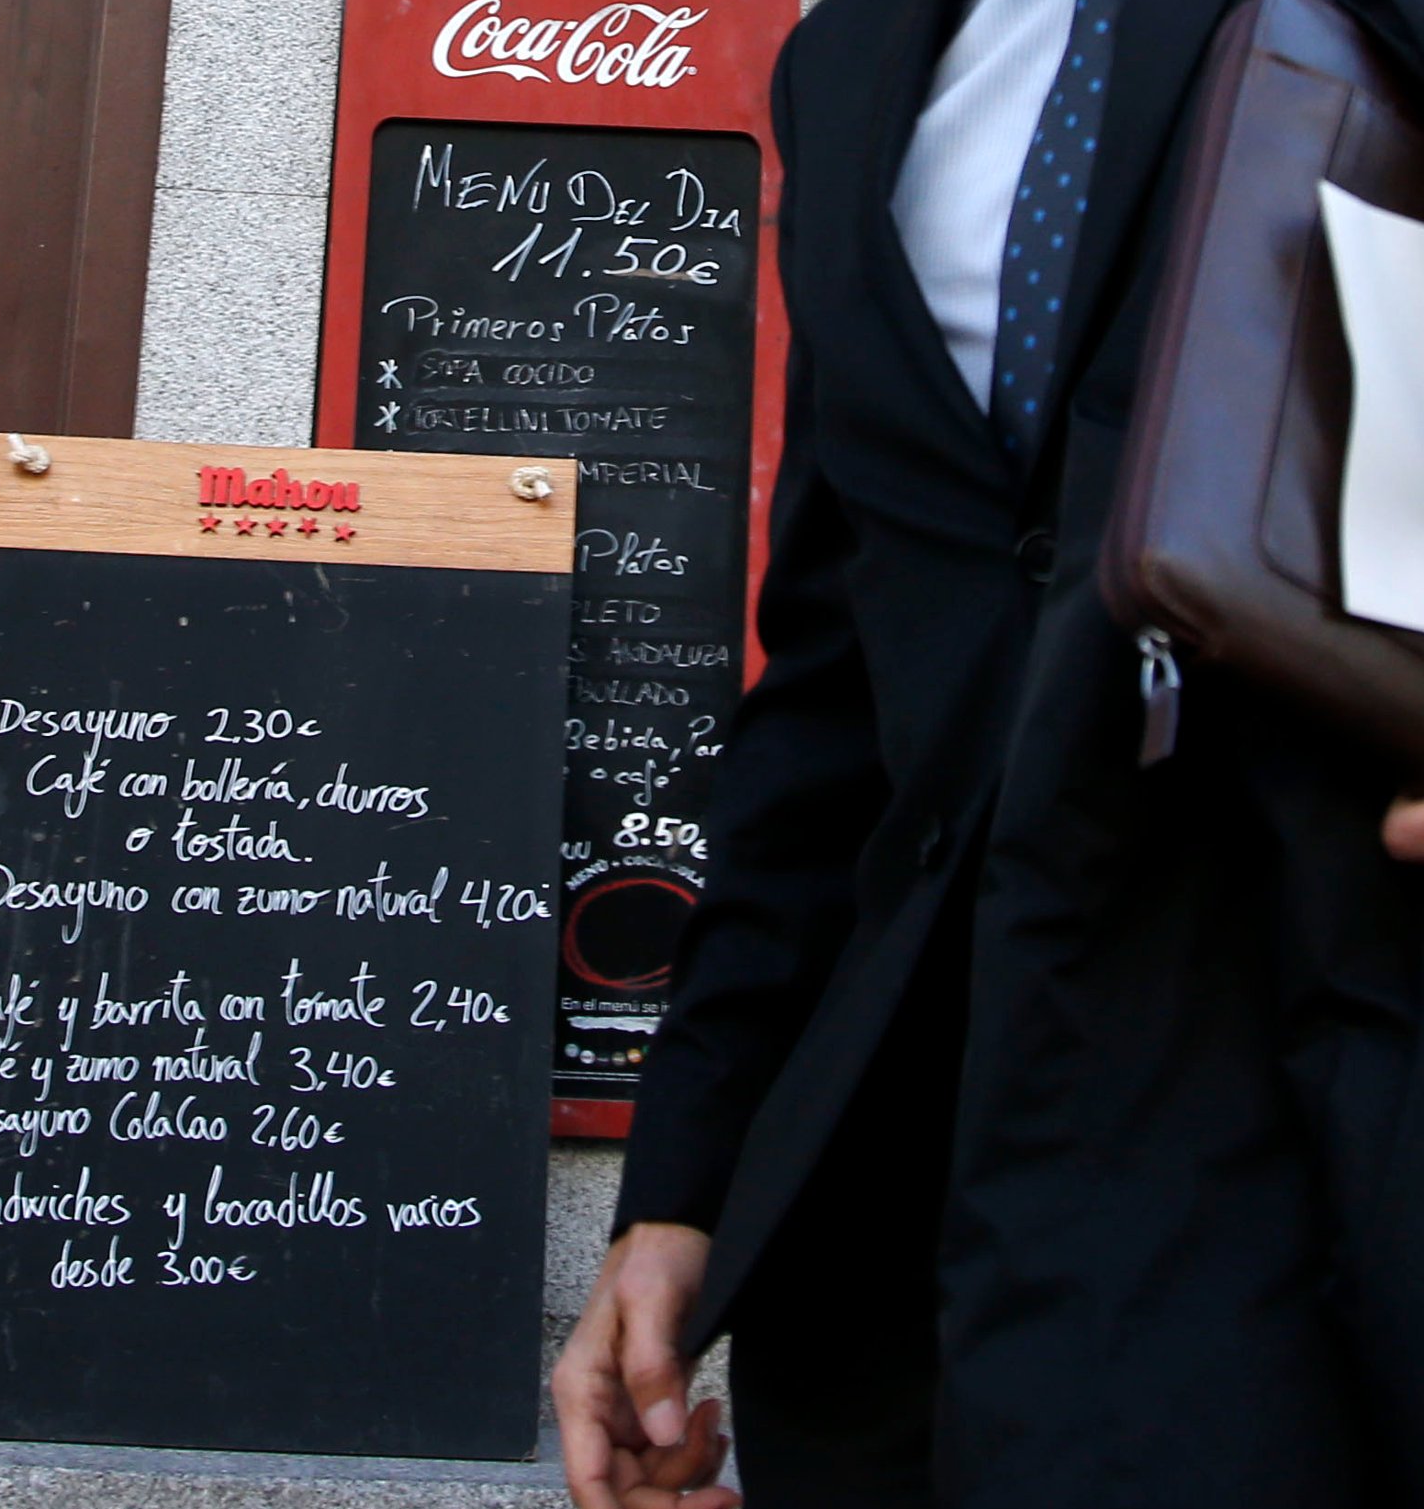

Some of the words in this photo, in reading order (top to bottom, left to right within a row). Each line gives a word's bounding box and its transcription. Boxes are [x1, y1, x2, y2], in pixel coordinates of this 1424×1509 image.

[491, 222, 720, 284] 11.50€
[381, 295, 564, 342] Primeros
[573, 292, 694, 344] Platos
[502, 363, 595, 385] COCIDO
[555, 405, 670, 432] TOMATE
[197, 465, 362, 512] Mahou
[578, 461, 716, 491] MPERIAL
[575, 528, 689, 576] Platos
[26, 754, 112, 819] Café
[118, 772, 168, 798] con
[315, 763, 431, 818] churros
[614, 759, 681, 807] café
[125, 826, 156, 853] o
[171, 885, 224, 915] con
[236, 885, 333, 916] zumo
[335, 861, 449, 923] natural
[58, 997, 79, 1053] y
[89, 969, 206, 1030] barrita
[219, 993, 265, 1022] con
[280, 958, 386, 1028] tomate
[31, 1057, 54, 1102] y
[66, 1054, 140, 1083] zumo
[152, 1027, 263, 1086] natural
[163, 1192, 187, 1250] y
[204, 1165, 368, 1230] bocadillos
[386, 1193, 482, 1233] varios
[51, 1235, 136, 1288] desde
